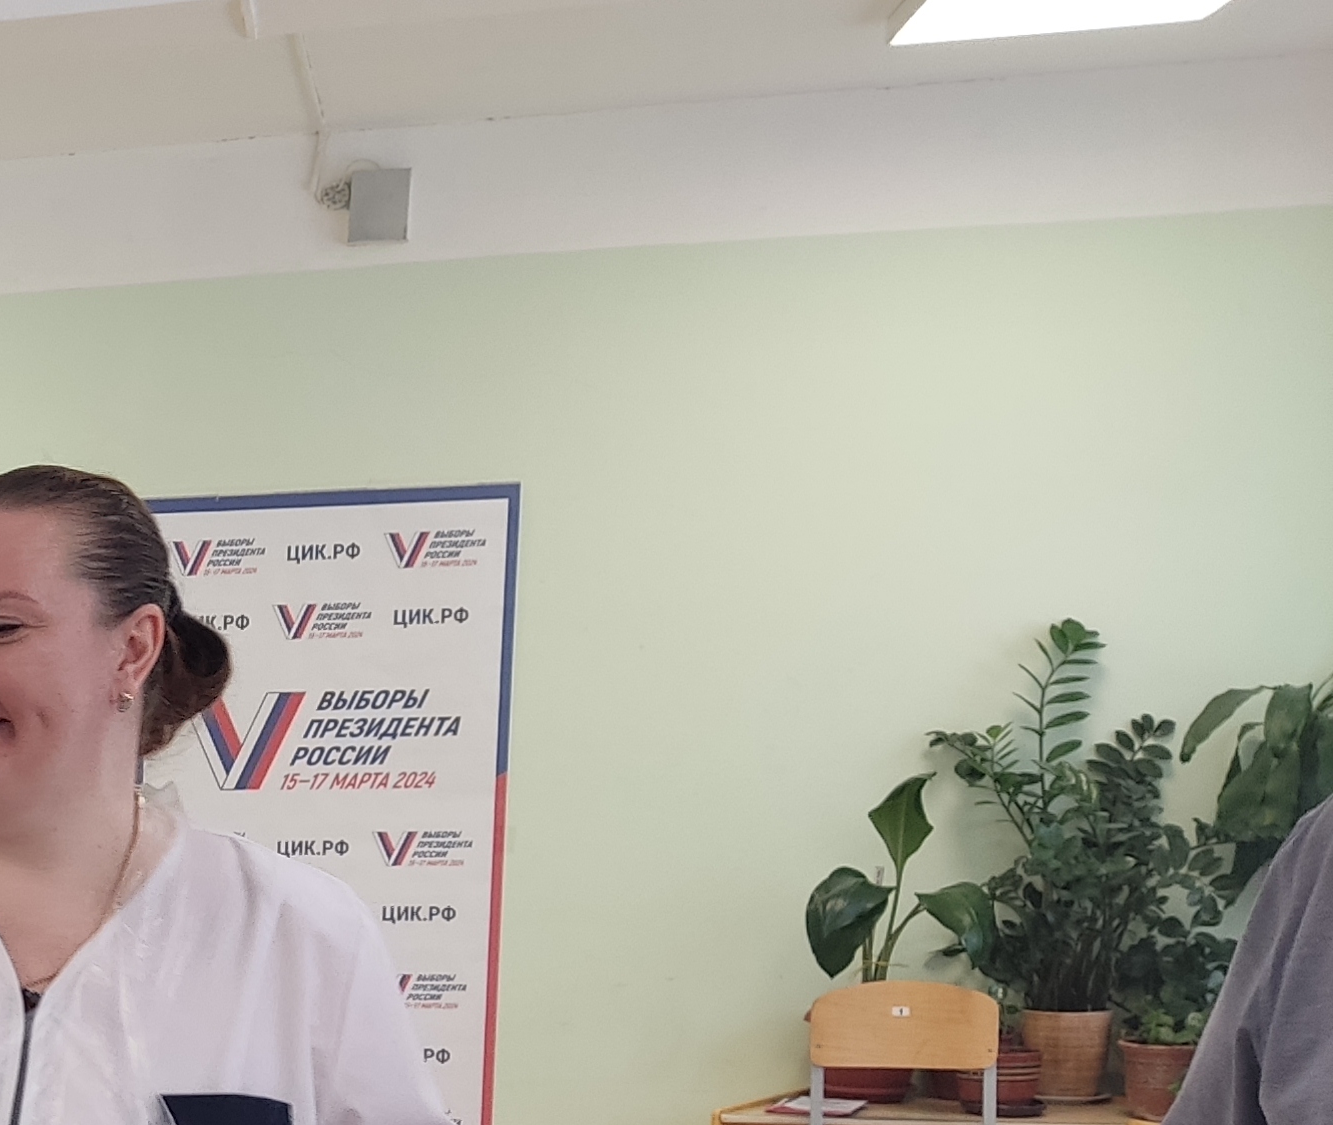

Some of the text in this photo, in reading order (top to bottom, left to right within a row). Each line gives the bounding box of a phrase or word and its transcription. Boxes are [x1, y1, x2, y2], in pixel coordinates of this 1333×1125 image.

[434, 529, 476, 538] ВЫБОРЫ
[216, 538, 255, 547] ВЫБОРЫ
[429, 539, 486, 549] ПРЕЗИДЕНТА
[211, 547, 266, 557] ПРЕЗИДЕНТА
[286, 543, 361, 564] ЦИК.РФ
[424, 549, 462, 559] РОССИИ
[207, 558, 242, 567] РОССИИ
[321, 602, 361, 611] ВЫБОРЫ
[199, 614, 250, 631] К.РФ
[316, 612, 372, 621] ПРЕЗИДЕНТА
[393, 607, 469, 628] ЦИК.РФ
[311, 622, 348, 631] РОССИИ
[316, 689, 430, 711] ВЫБОРЫ
[303, 716, 461, 740] ПРЕЗИДЕНТА
[290, 745, 392, 766] РОССИИ
[329, 772, 390, 790] МАРТА
[392, 771, 436, 789] 2024
[276, 839, 350, 858] ЦИК.РФ
[382, 905, 457, 924] ЦИК.РФ
[423, 1047, 451, 1065] РФ
